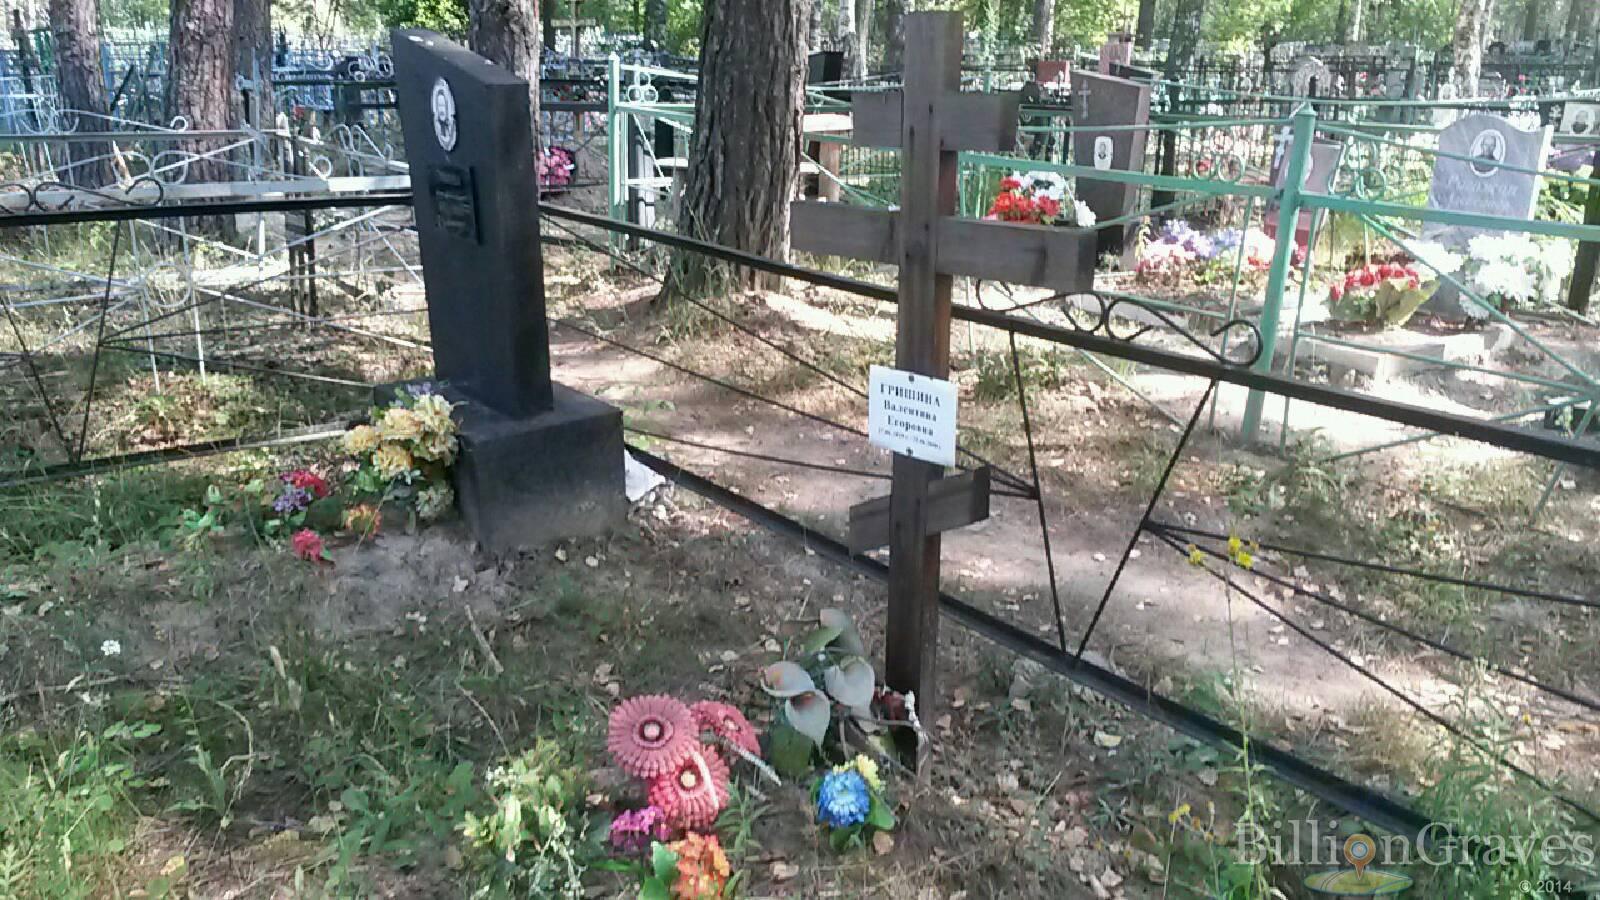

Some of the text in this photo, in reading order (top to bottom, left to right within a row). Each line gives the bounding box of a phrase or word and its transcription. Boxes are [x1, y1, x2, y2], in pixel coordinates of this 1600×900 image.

[881, 383, 941, 407] ГРИШИНА
[884, 399, 937, 422] Валентина
[887, 415, 934, 437] Егоровна
